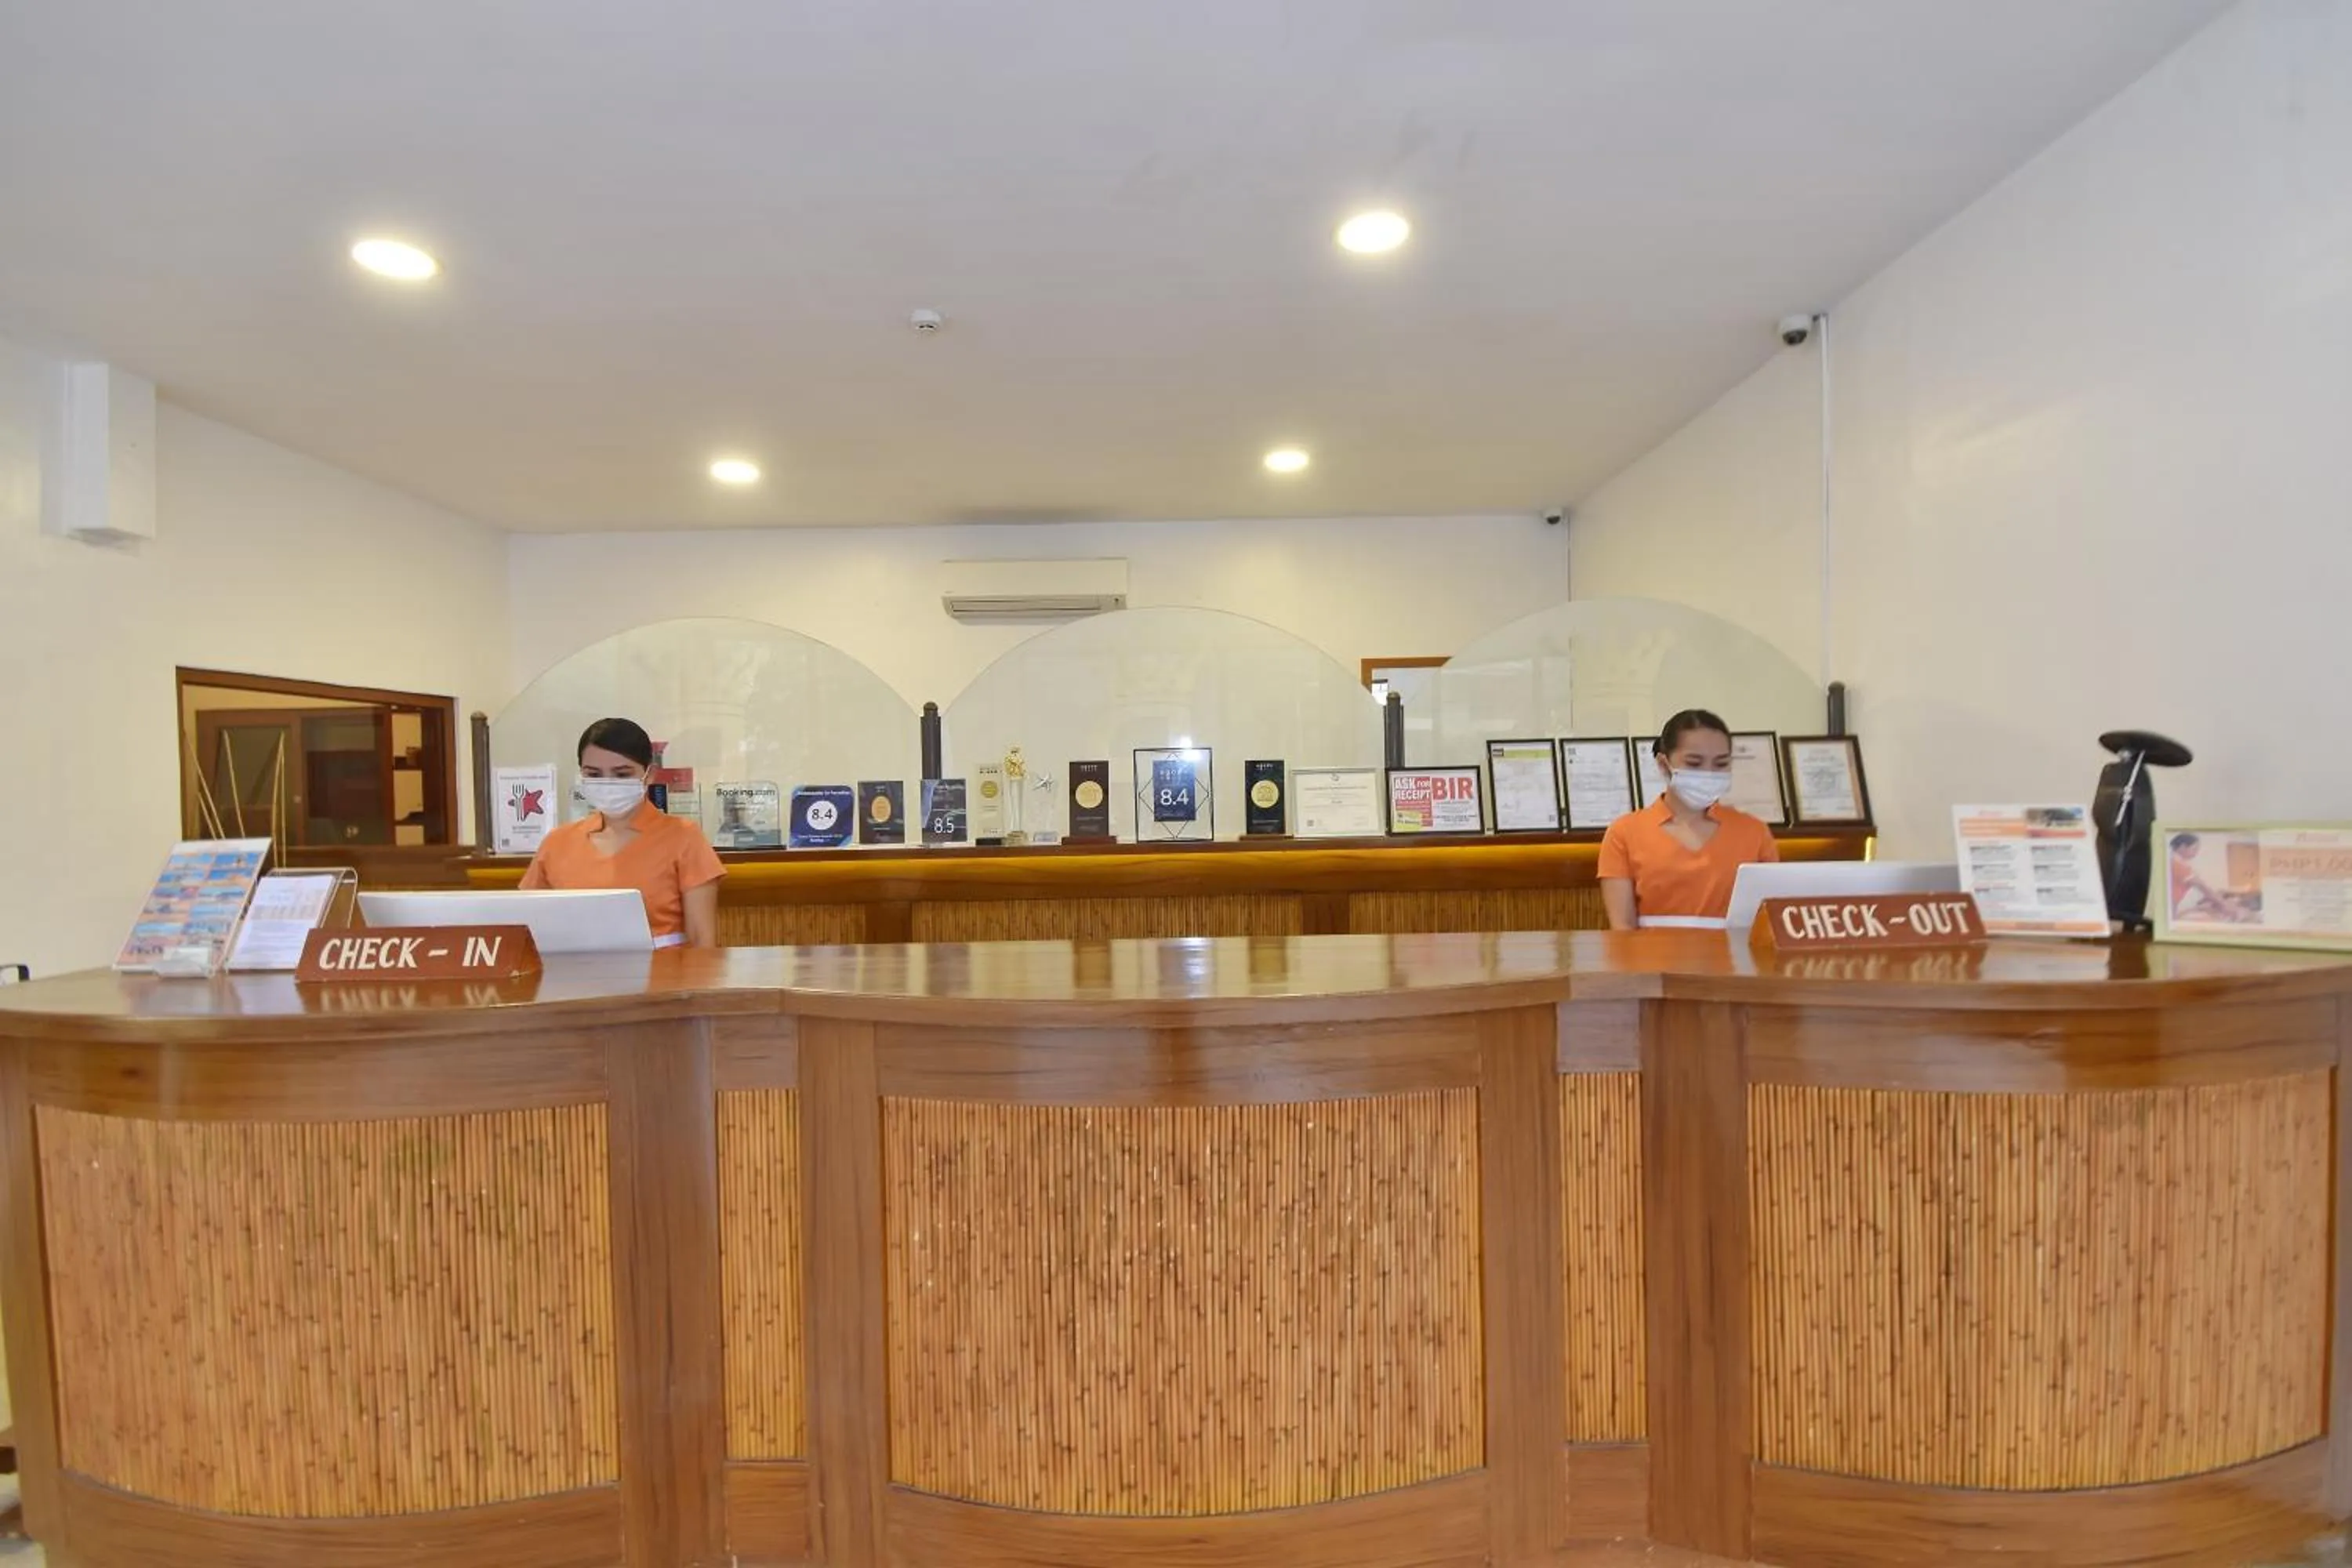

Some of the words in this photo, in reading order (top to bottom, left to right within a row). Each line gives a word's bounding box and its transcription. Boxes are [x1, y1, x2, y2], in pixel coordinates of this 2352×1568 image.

[1395, 777, 1414, 789] ASK
[1432, 777, 1474, 800] BIR
[1160, 788, 1189, 806] 8.4
[1395, 789, 1431, 800] RECEIPT
[811, 808, 833, 820] 8.4
[934, 817, 954, 833] 8.5
[318, 937, 424, 970] CHECK
[462, 936, 503, 967] IN
